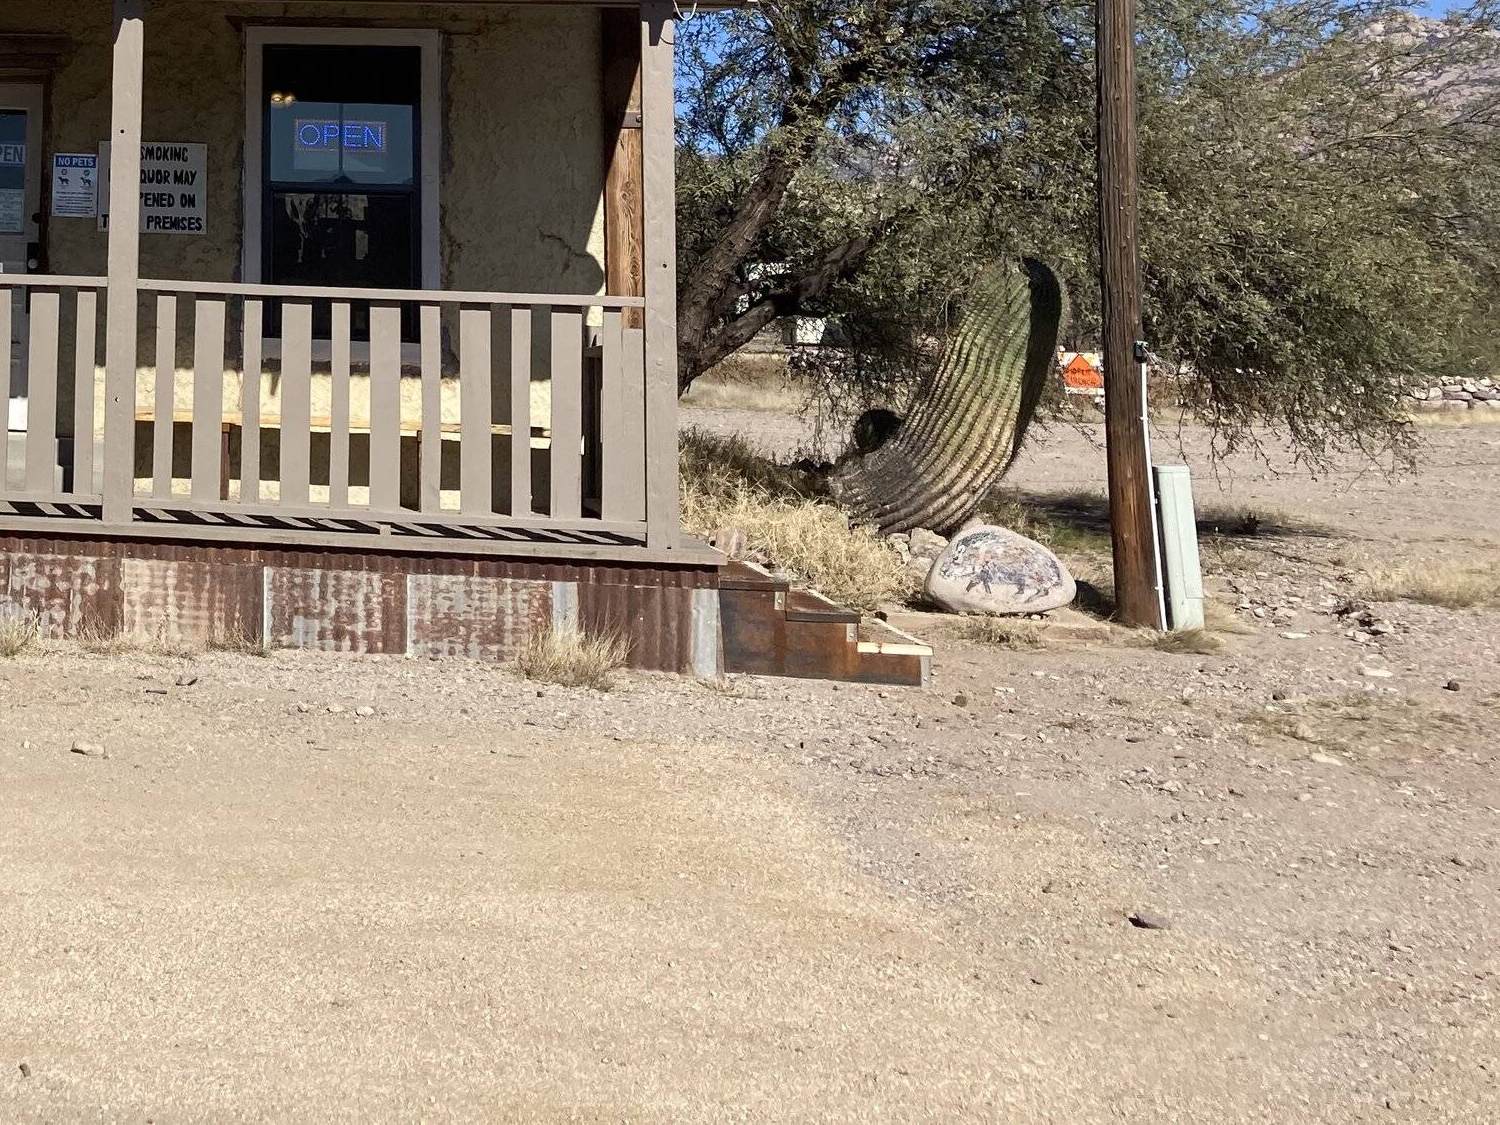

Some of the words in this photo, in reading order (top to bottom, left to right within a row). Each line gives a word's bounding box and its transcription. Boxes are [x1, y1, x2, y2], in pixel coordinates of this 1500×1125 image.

[299, 124, 383, 148] OPEN
[58, 157, 71, 167] NO
[72, 157, 94, 167] PETS
[140, 145, 189, 163] SMOKING
[140, 168, 171, 185] QUOR
[173, 169, 197, 186] MAY
[180, 193, 196, 208] ON
